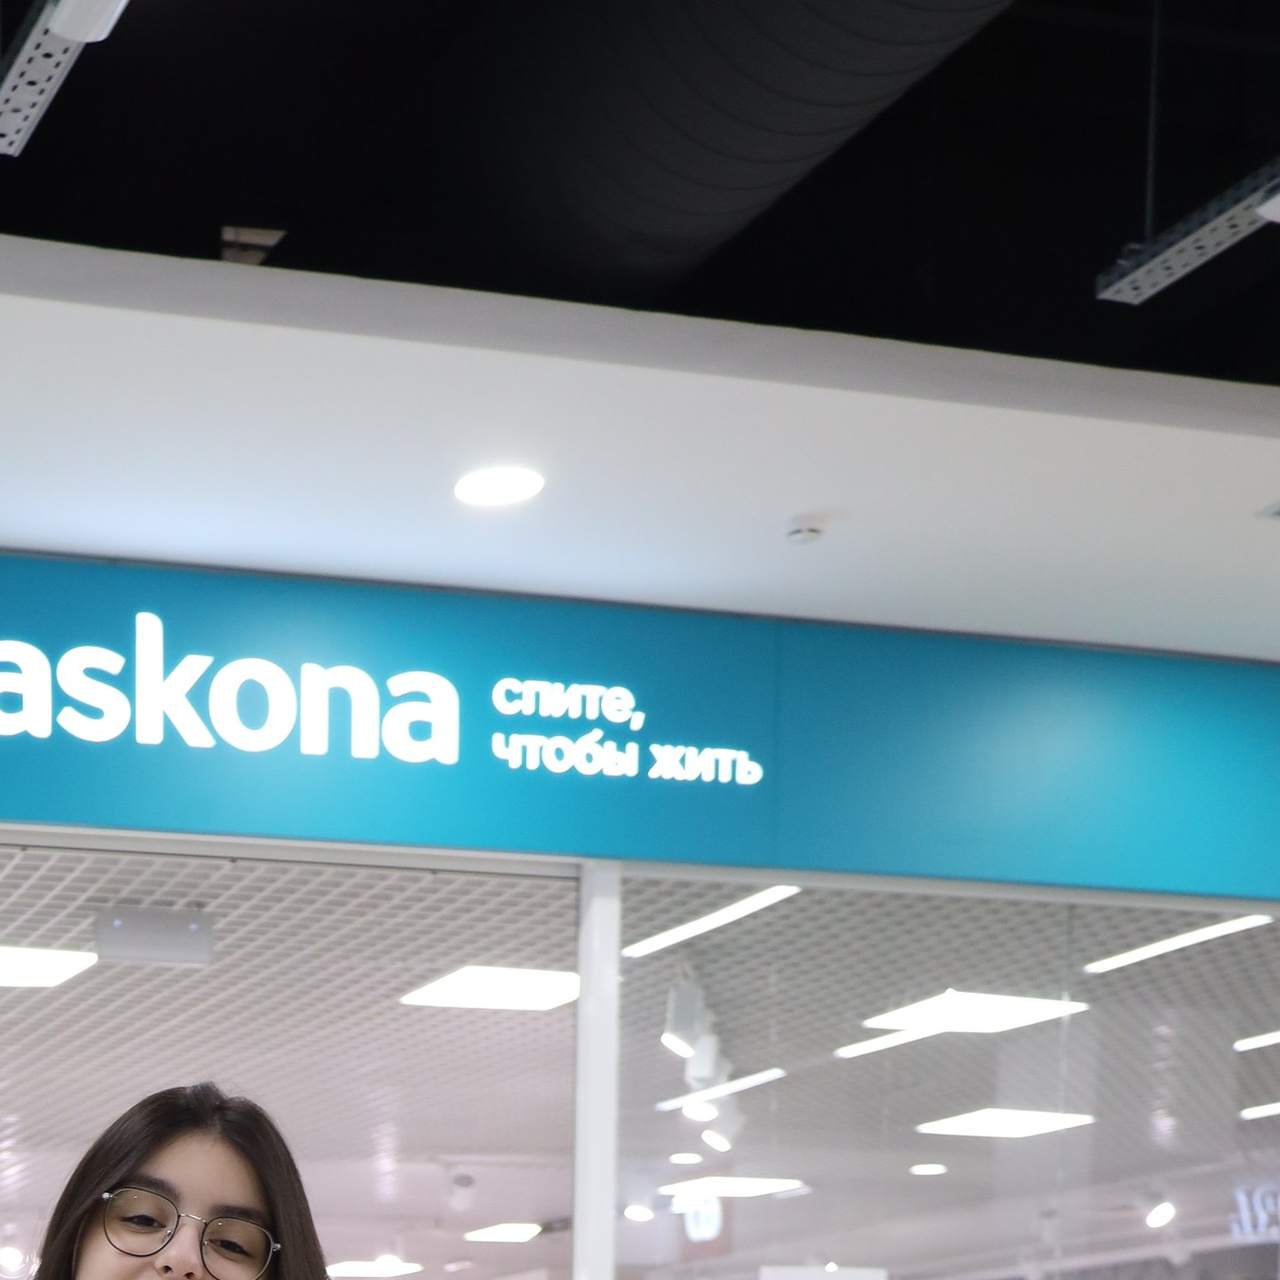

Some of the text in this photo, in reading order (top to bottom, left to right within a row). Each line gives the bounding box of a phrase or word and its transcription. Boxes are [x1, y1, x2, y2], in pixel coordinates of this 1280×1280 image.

[491, 676, 645, 731] спите,
[491, 728, 763, 785] чтобы жить
